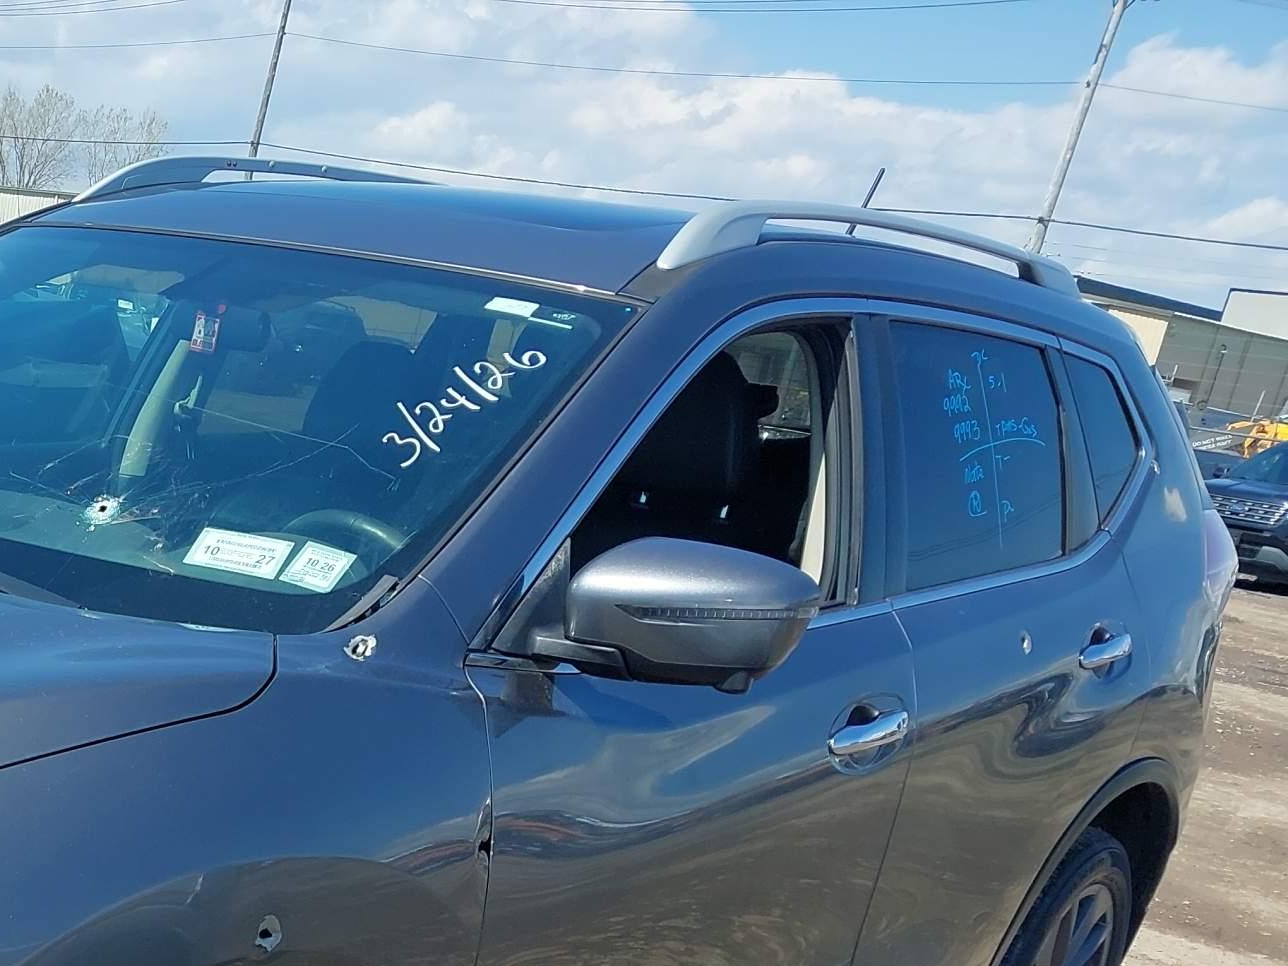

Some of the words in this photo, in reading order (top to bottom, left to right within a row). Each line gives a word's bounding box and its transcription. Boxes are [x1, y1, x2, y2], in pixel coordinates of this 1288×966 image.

[382, 350, 547, 468] 3/24/26
[203, 545, 220, 556] 10
[254, 554, 276, 566] 27
[306, 557, 320, 568] 10
[320, 562, 337, 572] 26
